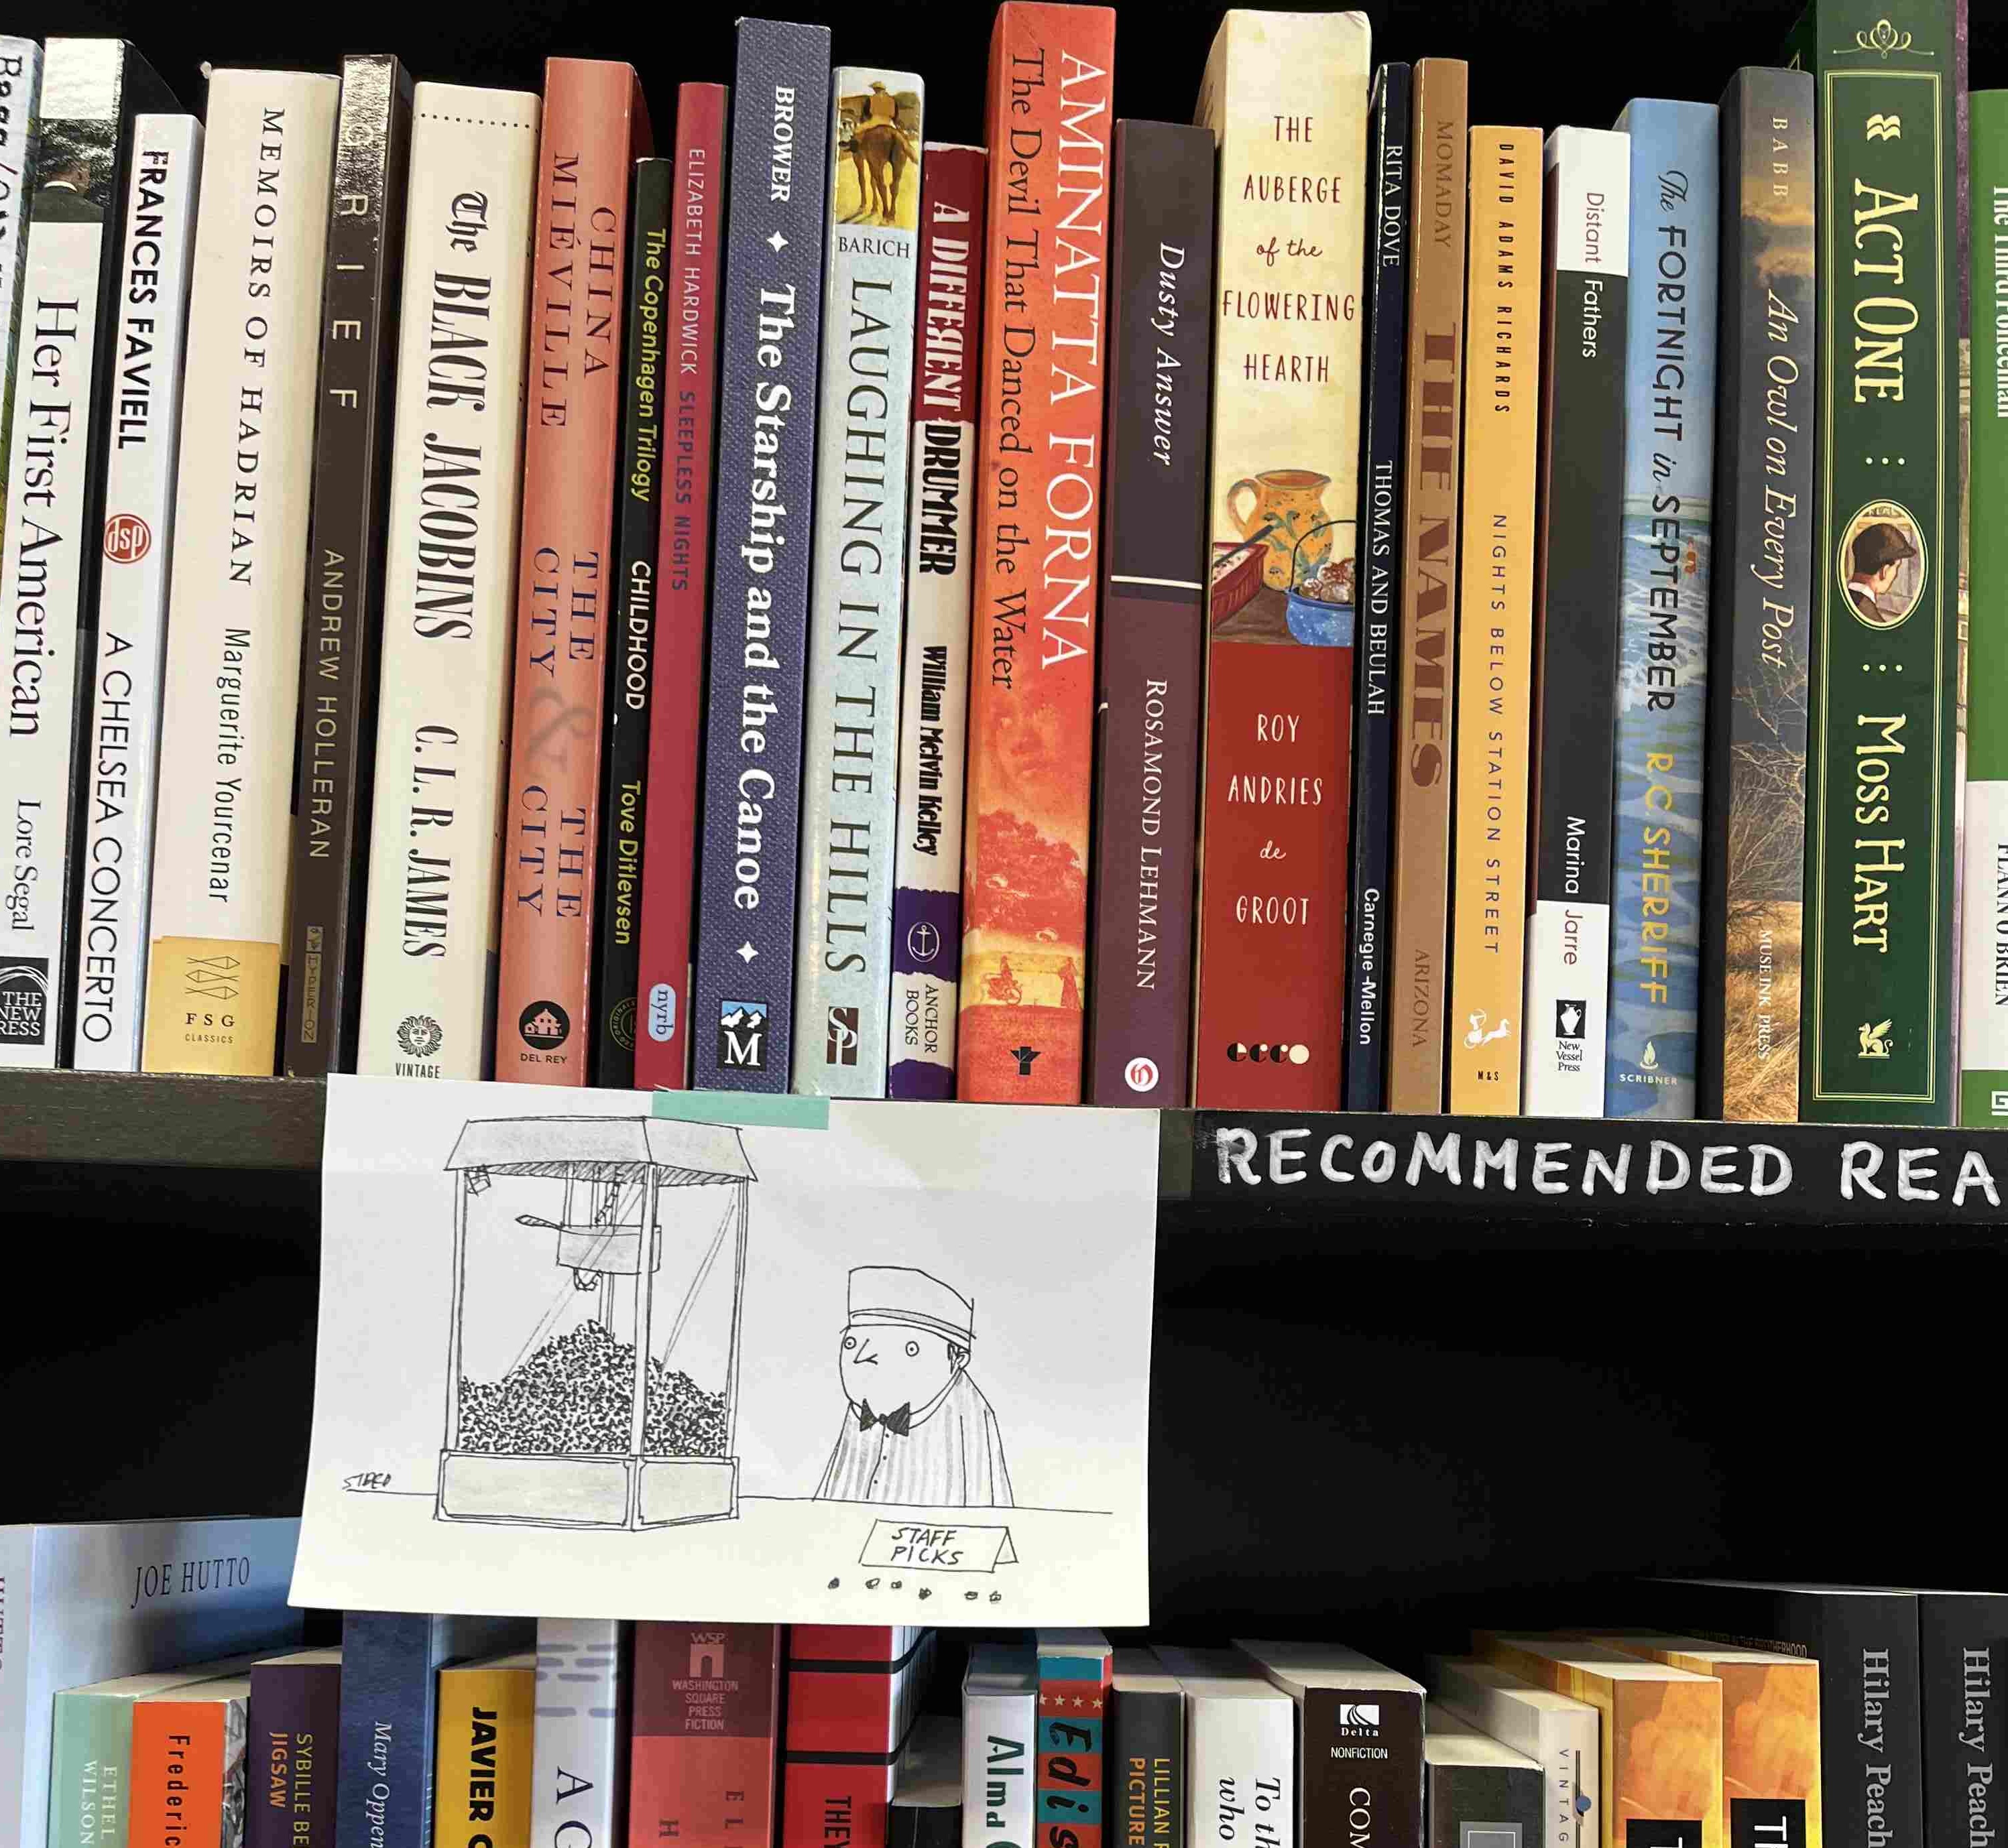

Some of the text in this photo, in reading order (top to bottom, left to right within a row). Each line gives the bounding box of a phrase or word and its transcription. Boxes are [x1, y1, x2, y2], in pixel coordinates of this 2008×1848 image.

[770, 85, 795, 202] BROWER
[1275, 116, 1313, 143] THE
[1433, 120, 1454, 248] MOMADAY
[1773, 117, 1788, 198] BABB
[1244, 175, 1342, 204] AUBERGE
[1380, 145, 1403, 267] RITA DOVE
[118, 150, 170, 450] FRANCES FAVIELL
[541, 152, 581, 427] MIÉVILLE
[584, 207, 617, 376] CHINA
[839, 236, 911, 259] BARICH
[1256, 237, 1323, 266] of the
[1494, 143, 1514, 414] DAVID ADAMS RICHARDS
[1583, 192, 1604, 359] Distant Fathers
[1853, 178, 1919, 403] ACT ONE
[230, 107, 285, 585] MEMOIRS OF HADRIAN
[1041, 50, 1107, 670] AMINATTA FORNA
[1148, 241, 1185, 467] Dusty Answer
[1222, 290, 1356, 321] FLOWERING
[412, 190, 492, 641] The BLACK JACOBINS
[630, 229, 666, 503] The Copenhagen Trilogy
[671, 149, 705, 591] ELIZABETH HARDWICK SLEEPLESS NIGHTS
[918, 201, 970, 576] A DIFFERENT DRUMMER
[992, 48, 1045, 691] The Devil That Danced on the Water
[1244, 353, 1330, 383] HEARTH
[1646, 170, 1688, 712] The FORTNIGHT in SEPTEMBER
[1750, 290, 1799, 669] An Owl on Every Post
[9, 298, 79, 739] Her First American
[107, 521, 144, 553] dsp
[1409, 322, 1456, 788] THE NAMES
[530, 548, 560, 678] CITY
[569, 552, 599, 661] THE
[626, 561, 651, 711] CHILDHOOD
[734, 284, 796, 910] The Starship and the Canoe
[824, 278, 893, 975] LAUGHING IN THE HILLS
[1368, 460, 1393, 716] THOMAS AND BEULAH
[308, 550, 342, 857] ANDREW HOLLERAN
[913, 645, 947, 857] William Melvin Kelley
[1256, 713, 1301, 743] ROY
[1484, 515, 1507, 953] NIGHTS BELOW STATION STREET
[209, 628, 250, 902] Marguerite Yourcenar
[1228, 777, 1323, 806] ANDRIES
[5, 800, 41, 930] Lore Segal
[83, 632, 133, 1043] A CHELSEA CONCERTO
[402, 725, 460, 959] C. L. R. JAMES
[518, 786, 546, 918] CITY
[556, 808, 585, 918] THE
[615, 780, 642, 945] Tove Ditlevsen
[1136, 679, 1167, 991] ROSAMOND LEHMANN
[1260, 839, 1287, 861] de
[1853, 714, 1906, 953] MOSS HART
[1236, 895, 1309, 926] GROOT
[1563, 817, 1586, 966] Marina Jarre
[1640, 827, 1671, 1003] SHERRIFF
[3, 991, 42, 1006] THE
[185, 1032, 234, 1044] CLASSICS
[651, 990, 674, 1035] nyrb
[905, 989, 919, 1046] BOOKS
[924, 983, 939, 1054] ANCHOR
[1412, 949, 1429, 1048] ARIZONA
[1558, 1041, 1580, 1050] New
[1757, 930, 1773, 1060] MUSE INK PRESS
[396, 1062, 440, 1079] VINTAGE
[520, 1052, 568, 1065] DEL REY
[1555, 1050, 1583, 1062] Vessel
[1558, 1062, 1581, 1072] Press
[1619, 1072, 1677, 1086] SCRIBNER
[1216, 1127, 2003, 1207] RECOMMENDED REA
[131, 1556, 251, 1609] JOE HUTTO
[890, 1546, 964, 1565] PICKS
[891, 1527, 957, 1546] STAFF
[672, 1680, 739, 1691] WASHINGTON
[685, 1692, 726, 1705] SQUARE
[685, 1719, 724, 1730] FICTION
[689, 1705, 721, 1717] PRESS
[1341, 1727, 1379, 1737] Delta
[165, 1735, 190, 1847] Frederic
[268, 1731, 288, 1808] JIGSAW
[294, 1733, 314, 1814] SYBILLE
[367, 1721, 393, 1777] Mary
[469, 1707, 498, 1822] JAVIER
[1129, 1757, 1146, 1845] PICTURE
[1153, 1758, 1170, 1835] LILLIAN
[1254, 1777, 1281, 1812] To
[1330, 1745, 1389, 1760] NONFICTION
[1856, 1648, 1894, 1848] Hilary Peach
[1958, 1646, 1996, 1848] Hilary Peach
[80, 1760, 99, 1845] WILSON
[101, 1765, 117, 1841] ETHEL
[1218, 1776, 1245, 1841] who
